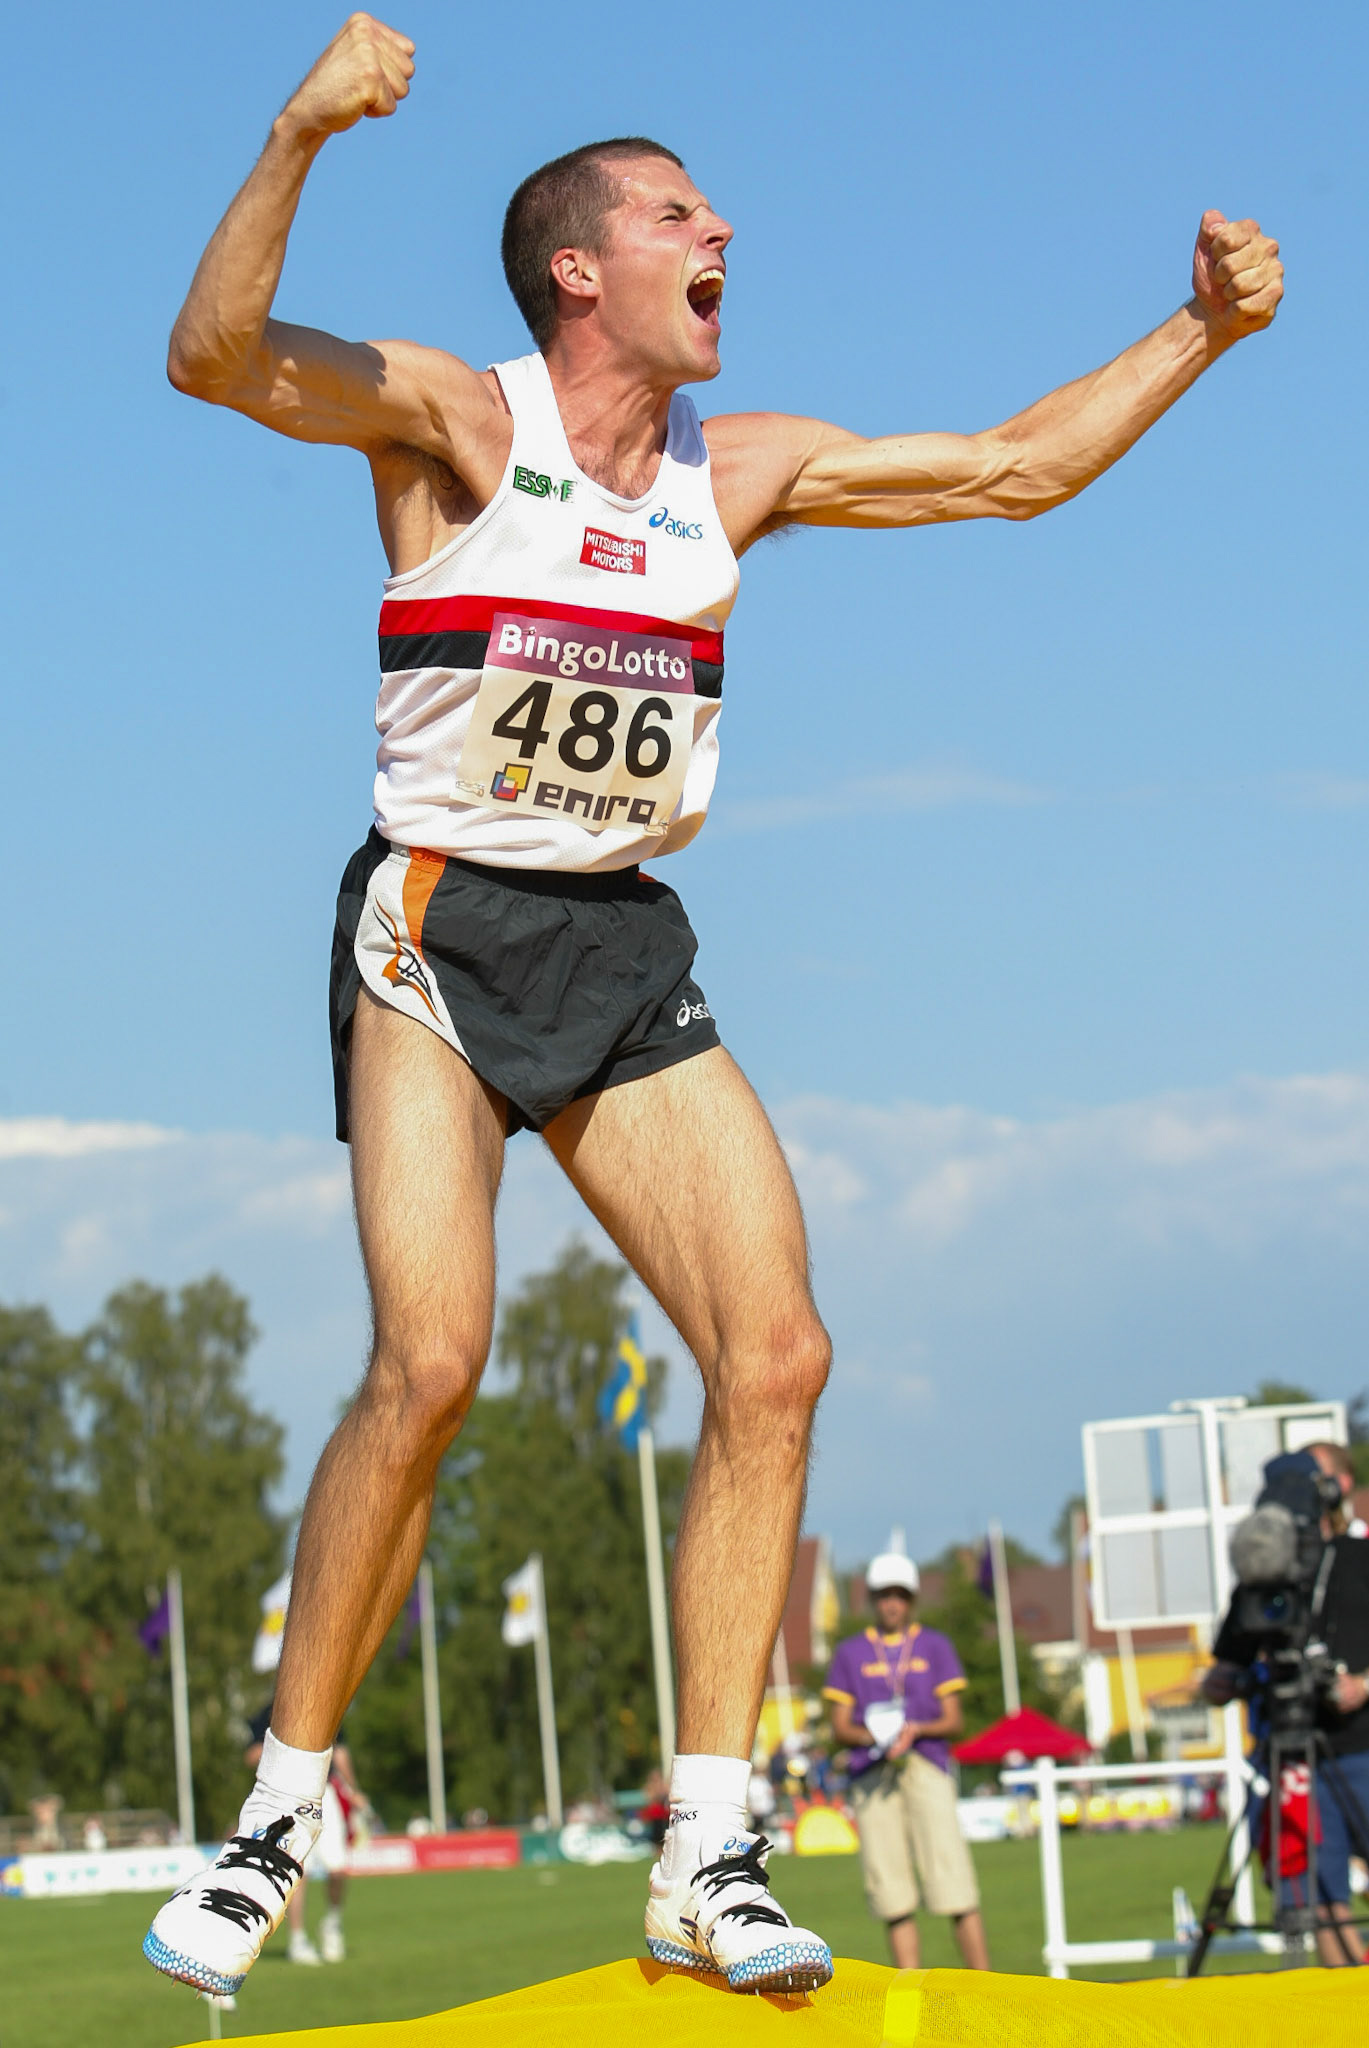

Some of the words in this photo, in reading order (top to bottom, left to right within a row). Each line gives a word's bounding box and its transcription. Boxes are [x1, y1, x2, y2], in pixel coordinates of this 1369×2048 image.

[591, 549, 634, 571] MOTORS
[497, 623, 687, 680] BingoLotto
[491, 680, 673, 778] 486
